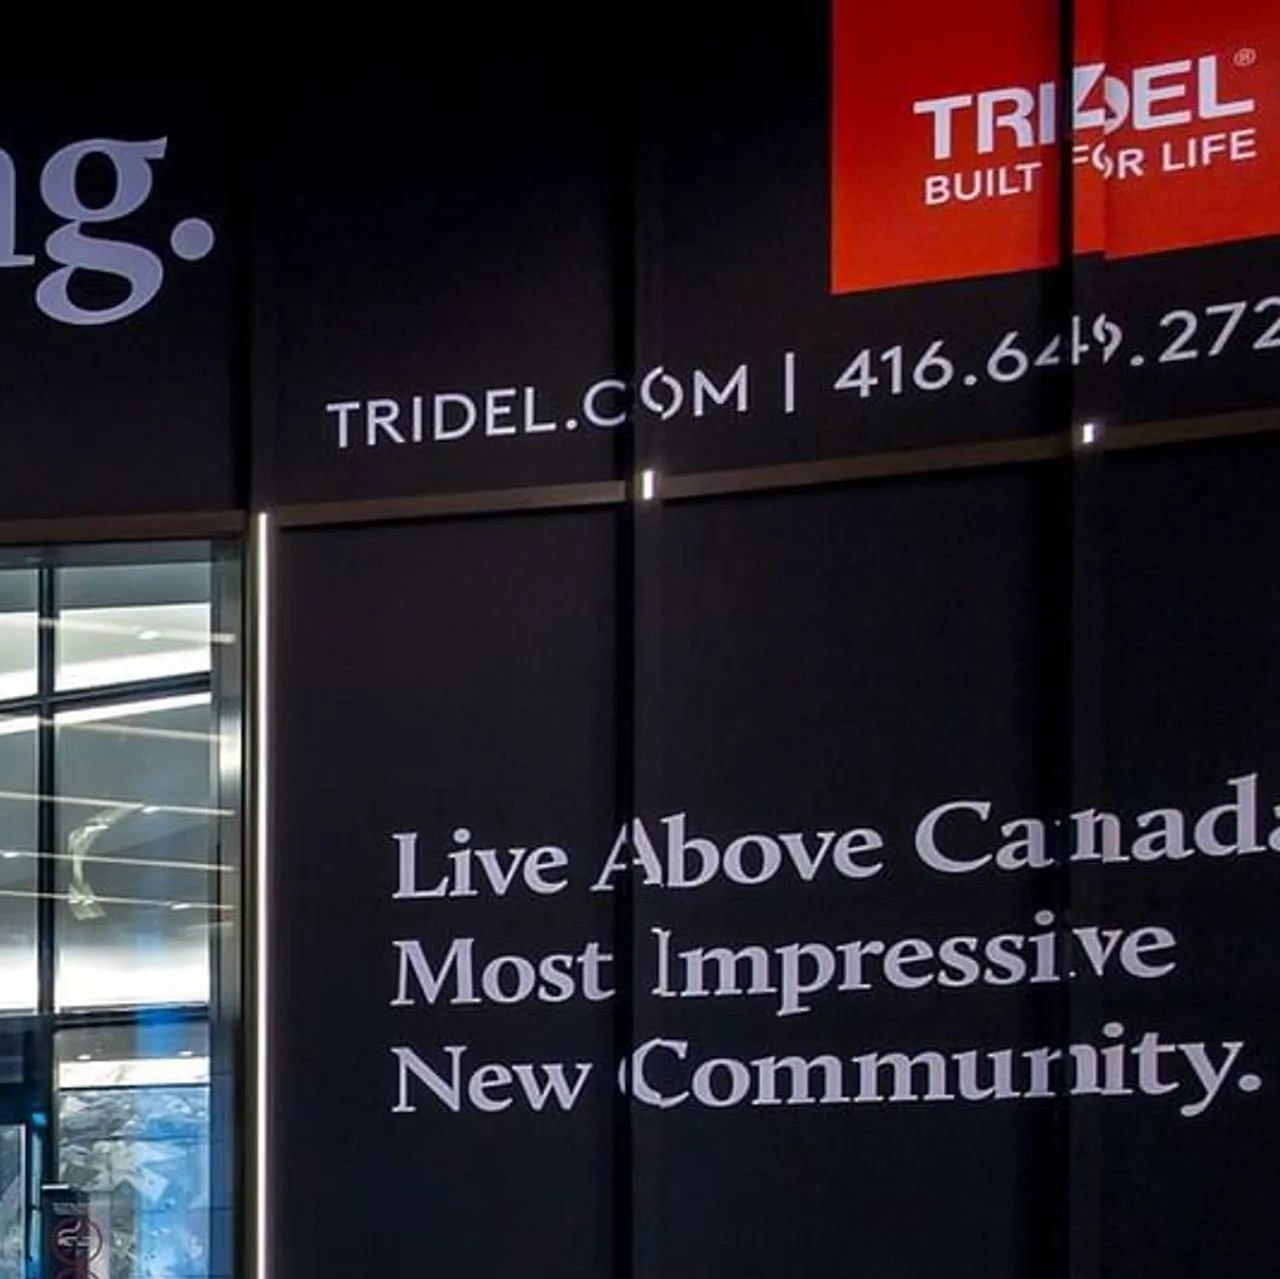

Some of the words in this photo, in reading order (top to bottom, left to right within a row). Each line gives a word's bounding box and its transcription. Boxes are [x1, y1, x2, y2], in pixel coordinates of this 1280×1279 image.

[925, 162, 1042, 205] BUILT
[1161, 128, 1257, 172] LIFE
[326, 364, 748, 448] TRIDEL.COM
[391, 827, 569, 899] Live
[589, 811, 884, 892] Above
[914, 773, 1280, 873] Canad
[389, 937, 617, 1007] Most
[650, 909, 1177, 1016] Impressive
[390, 1045, 593, 1113] New
[617, 1021, 1262, 1118] Community.
